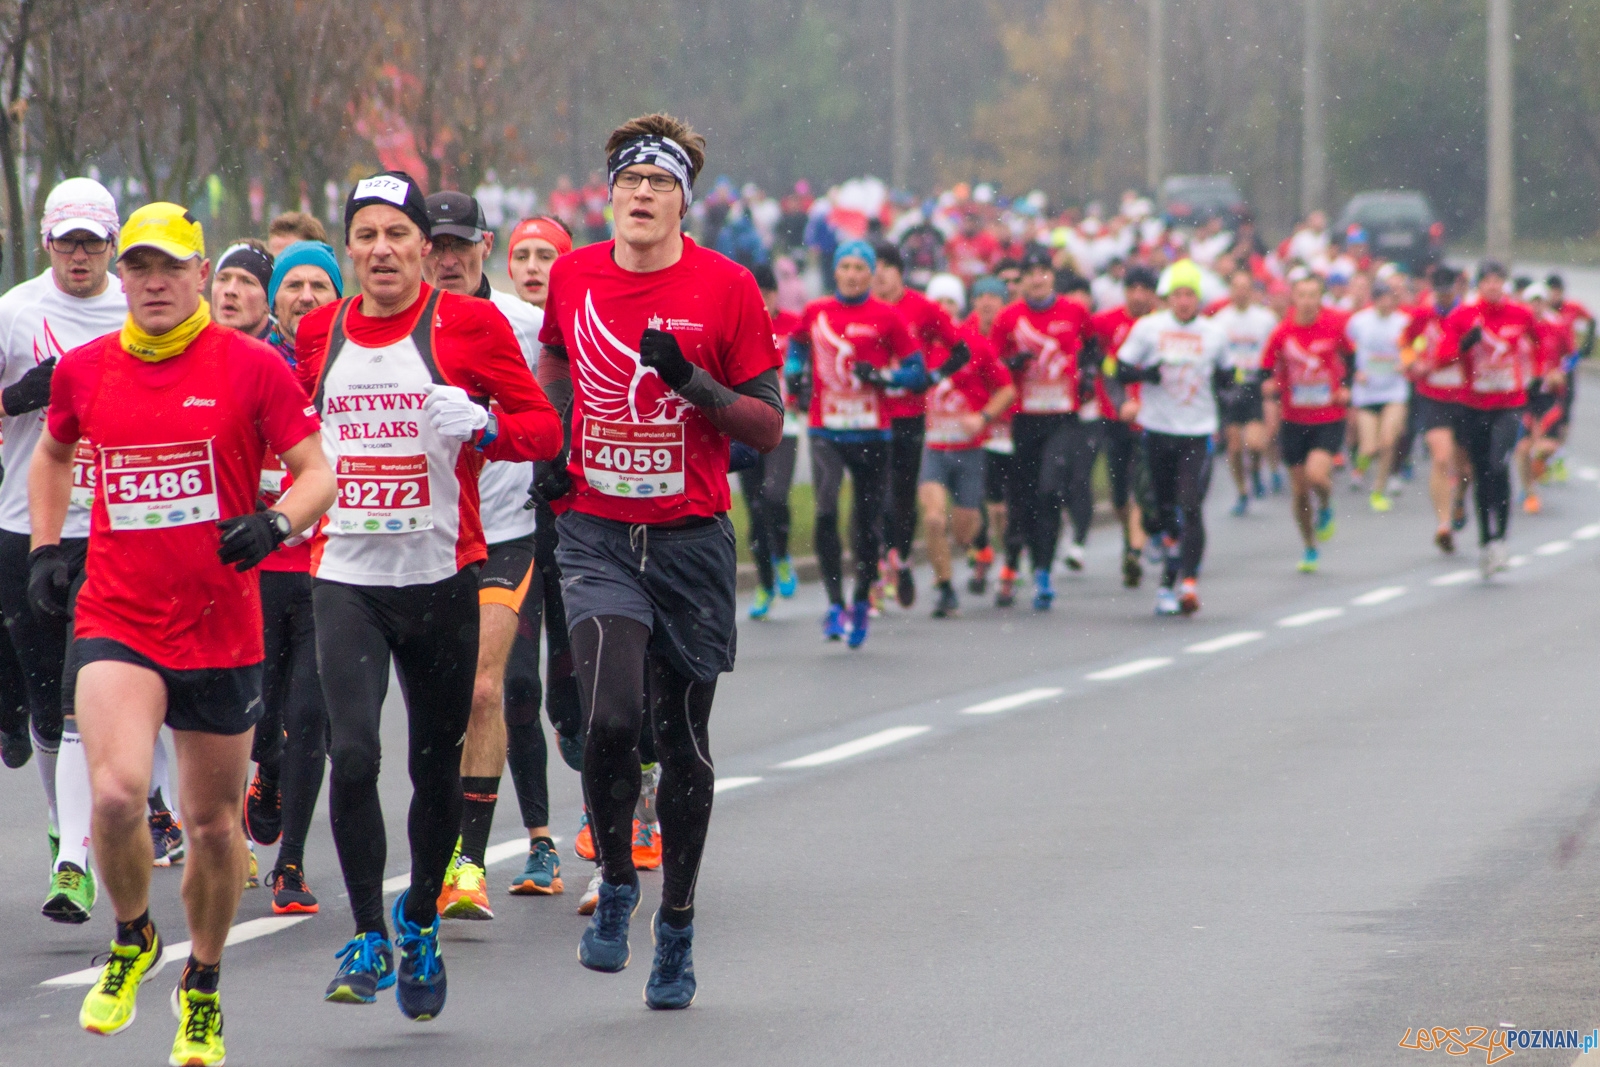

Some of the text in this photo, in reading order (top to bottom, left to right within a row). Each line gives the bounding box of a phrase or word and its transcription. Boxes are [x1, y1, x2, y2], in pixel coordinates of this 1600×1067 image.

[365, 179, 400, 191] 9272
[348, 382, 399, 390] TOWARZYSTWO
[327, 393, 428, 415] AKTYWNY
[339, 421, 419, 441] RELAKS
[633, 431, 676, 439] RunPoland.org
[381, 462, 423, 472] RunPoland.org
[595, 446, 671, 472] 4059
[120, 470, 202, 501] 5486
[618, 474, 644, 482] Szymon
[345, 481, 421, 507] 9272
